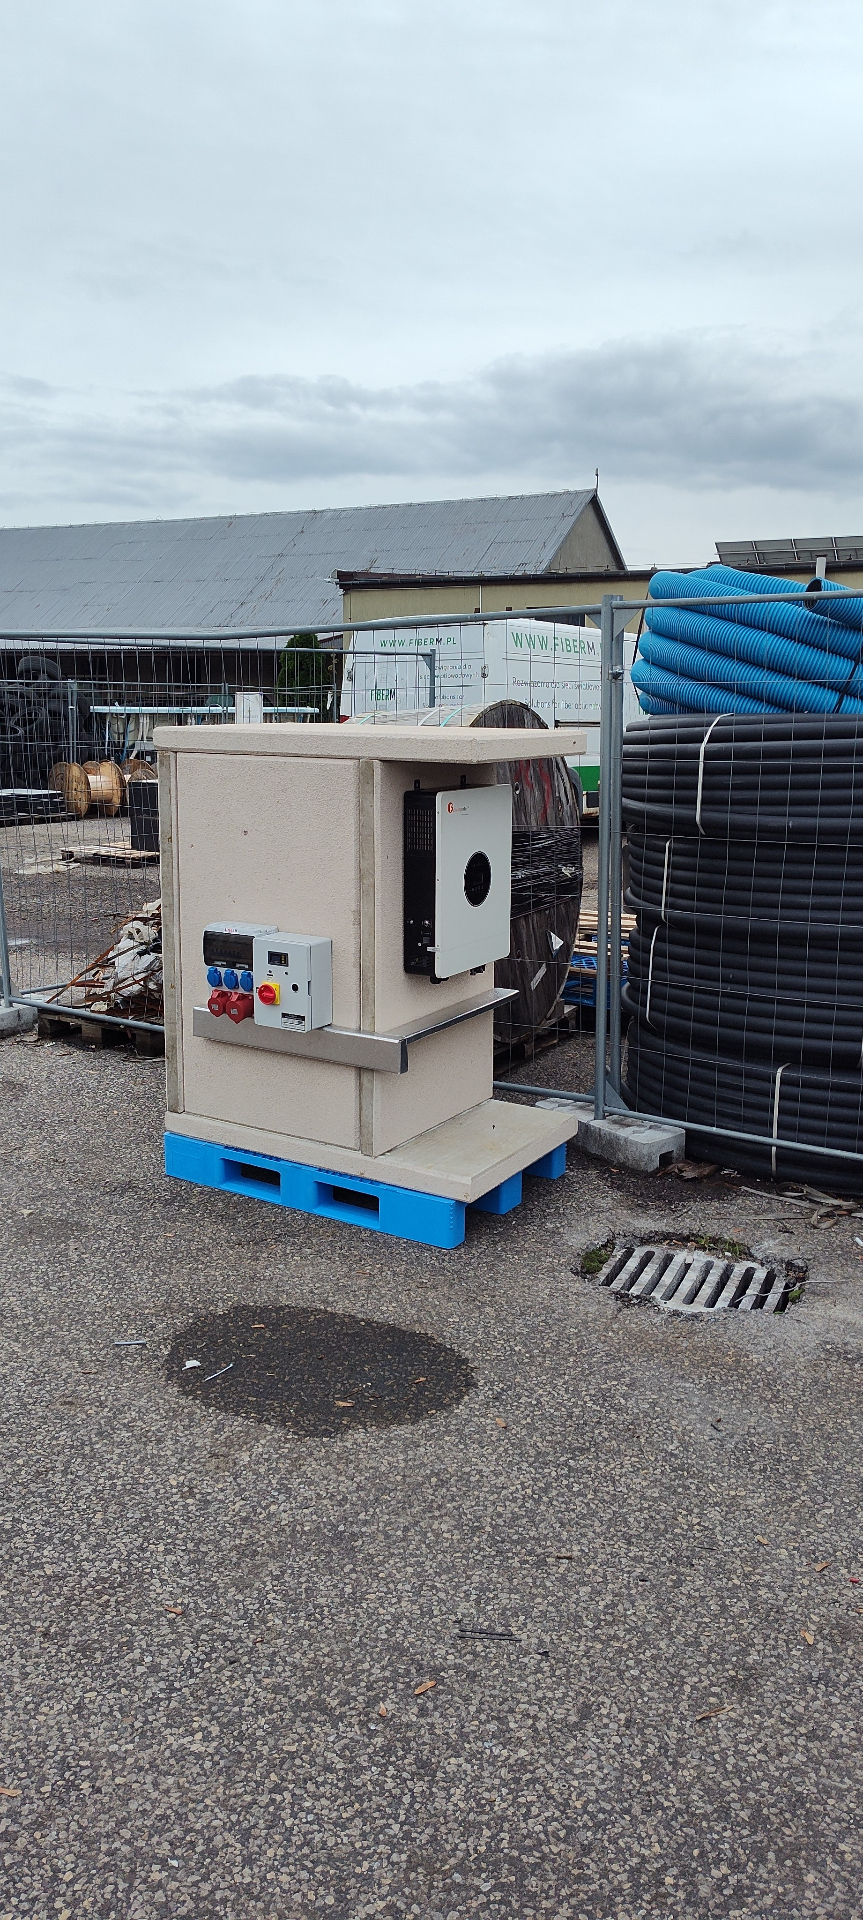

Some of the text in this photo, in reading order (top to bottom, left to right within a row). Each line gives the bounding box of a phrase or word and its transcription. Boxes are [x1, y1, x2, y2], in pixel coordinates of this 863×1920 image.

[380, 637, 457, 648] WWW.FIBERM.PL
[511, 632, 602, 656] WWW.FIBERM.
[370, 688, 396, 702] FIBERM
